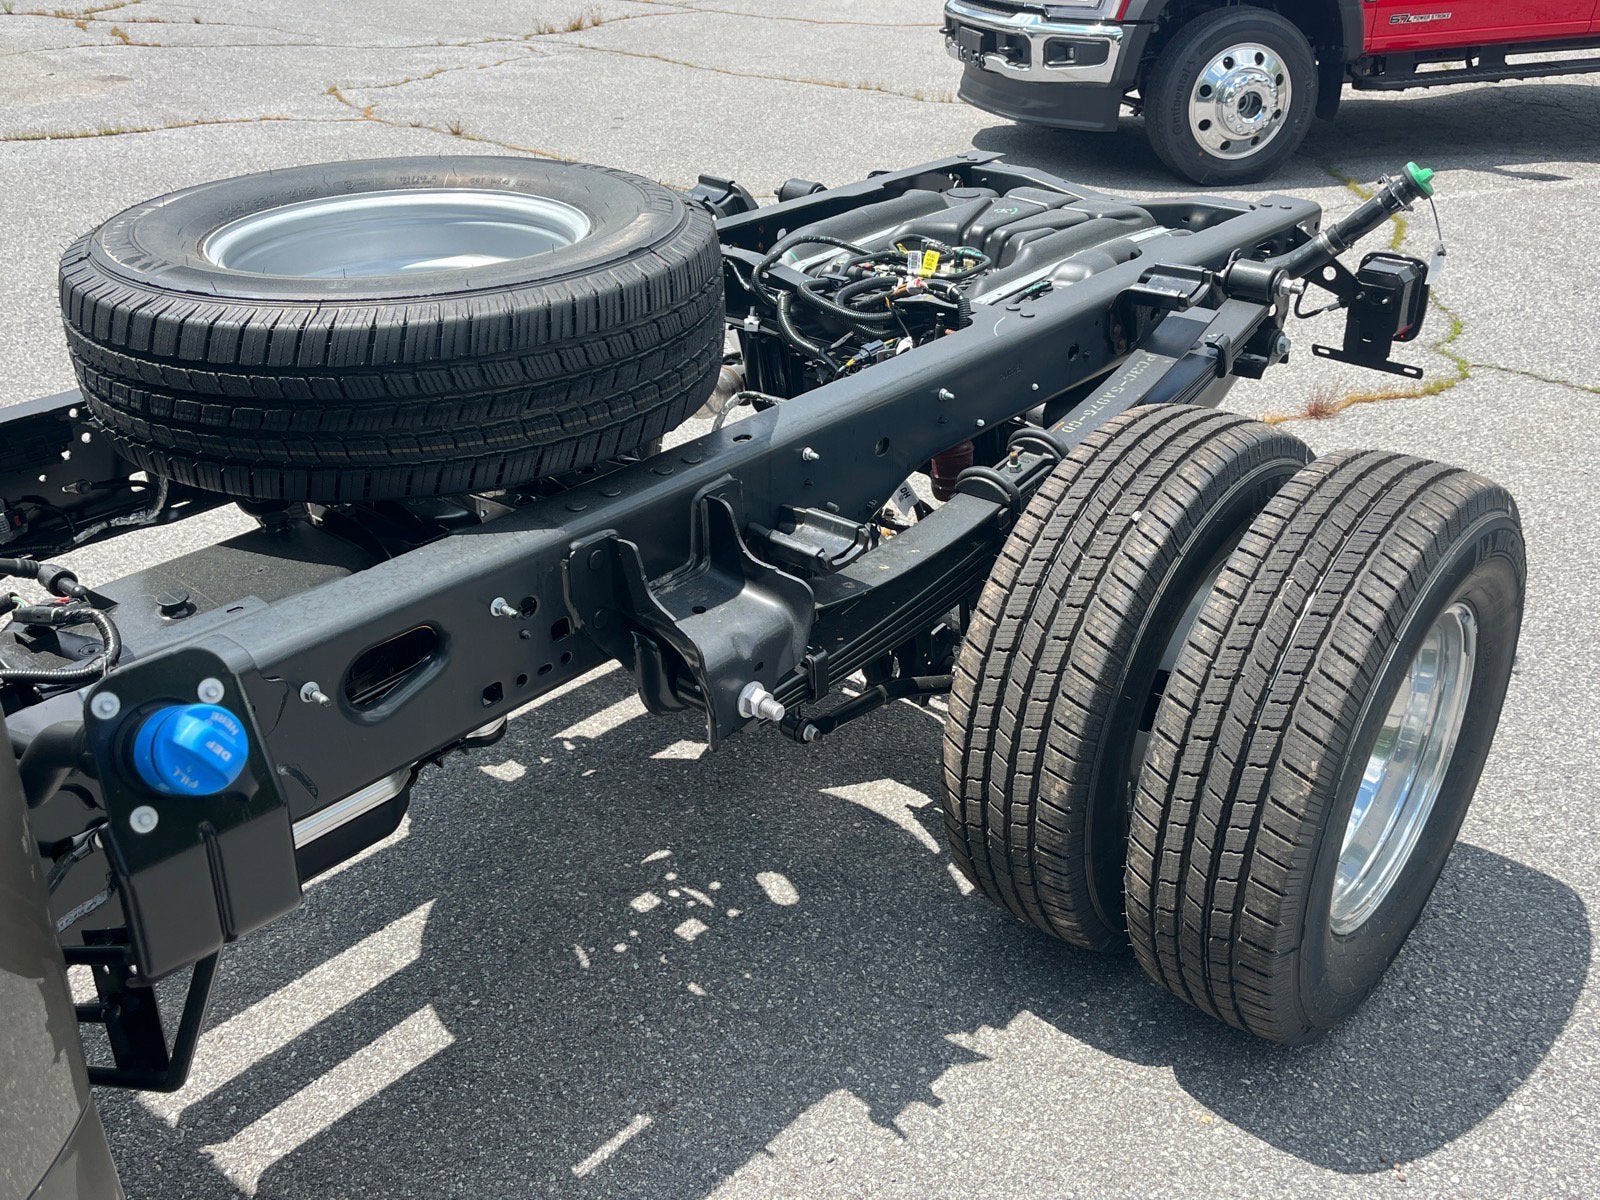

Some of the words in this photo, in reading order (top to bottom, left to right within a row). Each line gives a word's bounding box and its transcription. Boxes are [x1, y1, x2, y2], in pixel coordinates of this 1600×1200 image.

[900, 486, 911, 499] DH
[210, 711, 240, 736] HERE
[204, 740, 232, 762] DEF
[172, 765, 200, 789] FILL
